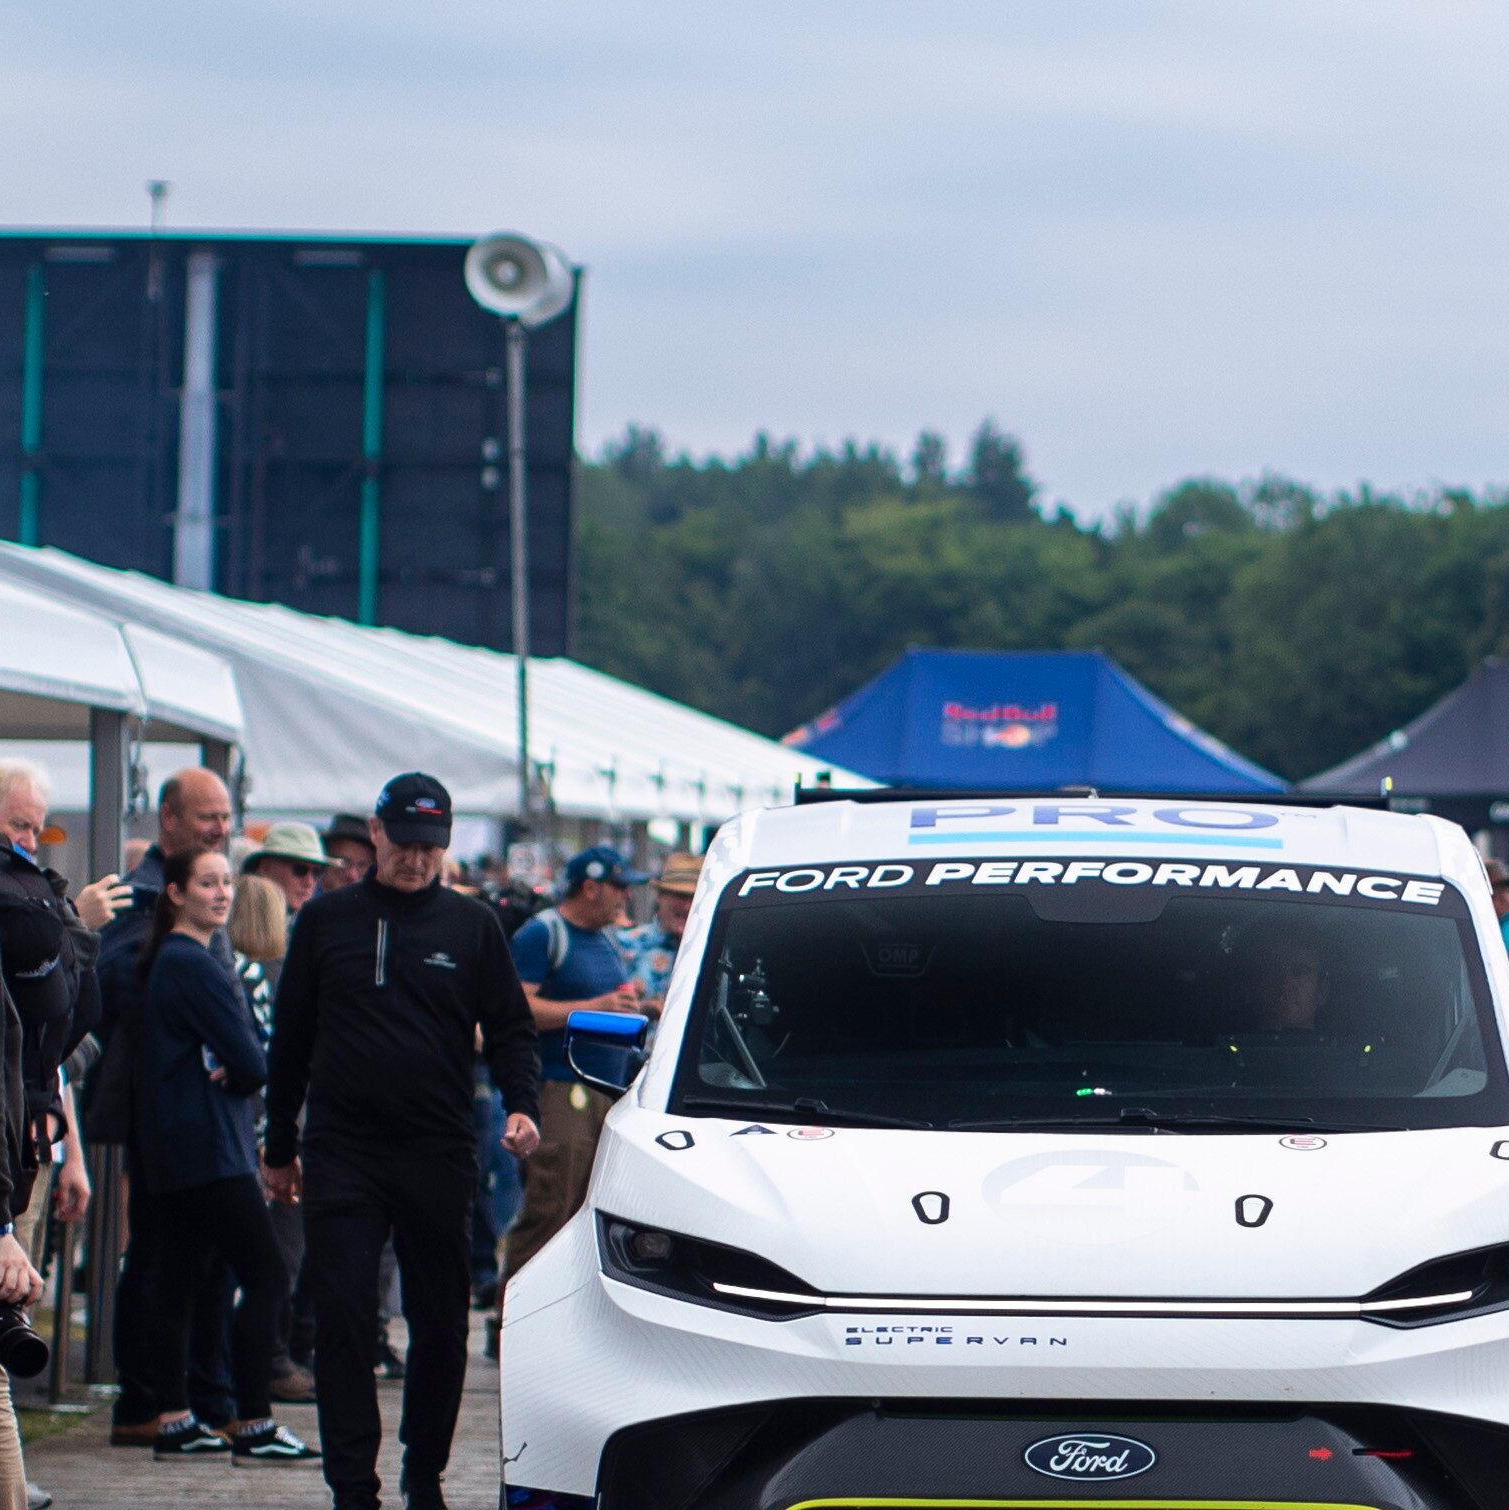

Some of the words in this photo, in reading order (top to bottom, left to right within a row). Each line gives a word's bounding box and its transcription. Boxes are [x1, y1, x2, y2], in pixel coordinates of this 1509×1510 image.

[909, 805, 1279, 830] PRO
[738, 863, 914, 897] FORD
[923, 861, 1446, 905] PERFORMANCE
[844, 1336, 1068, 1346] SUPERVAN
[845, 1325, 954, 1334] ELECTRIC
[1049, 1439, 1131, 1473] Ford
